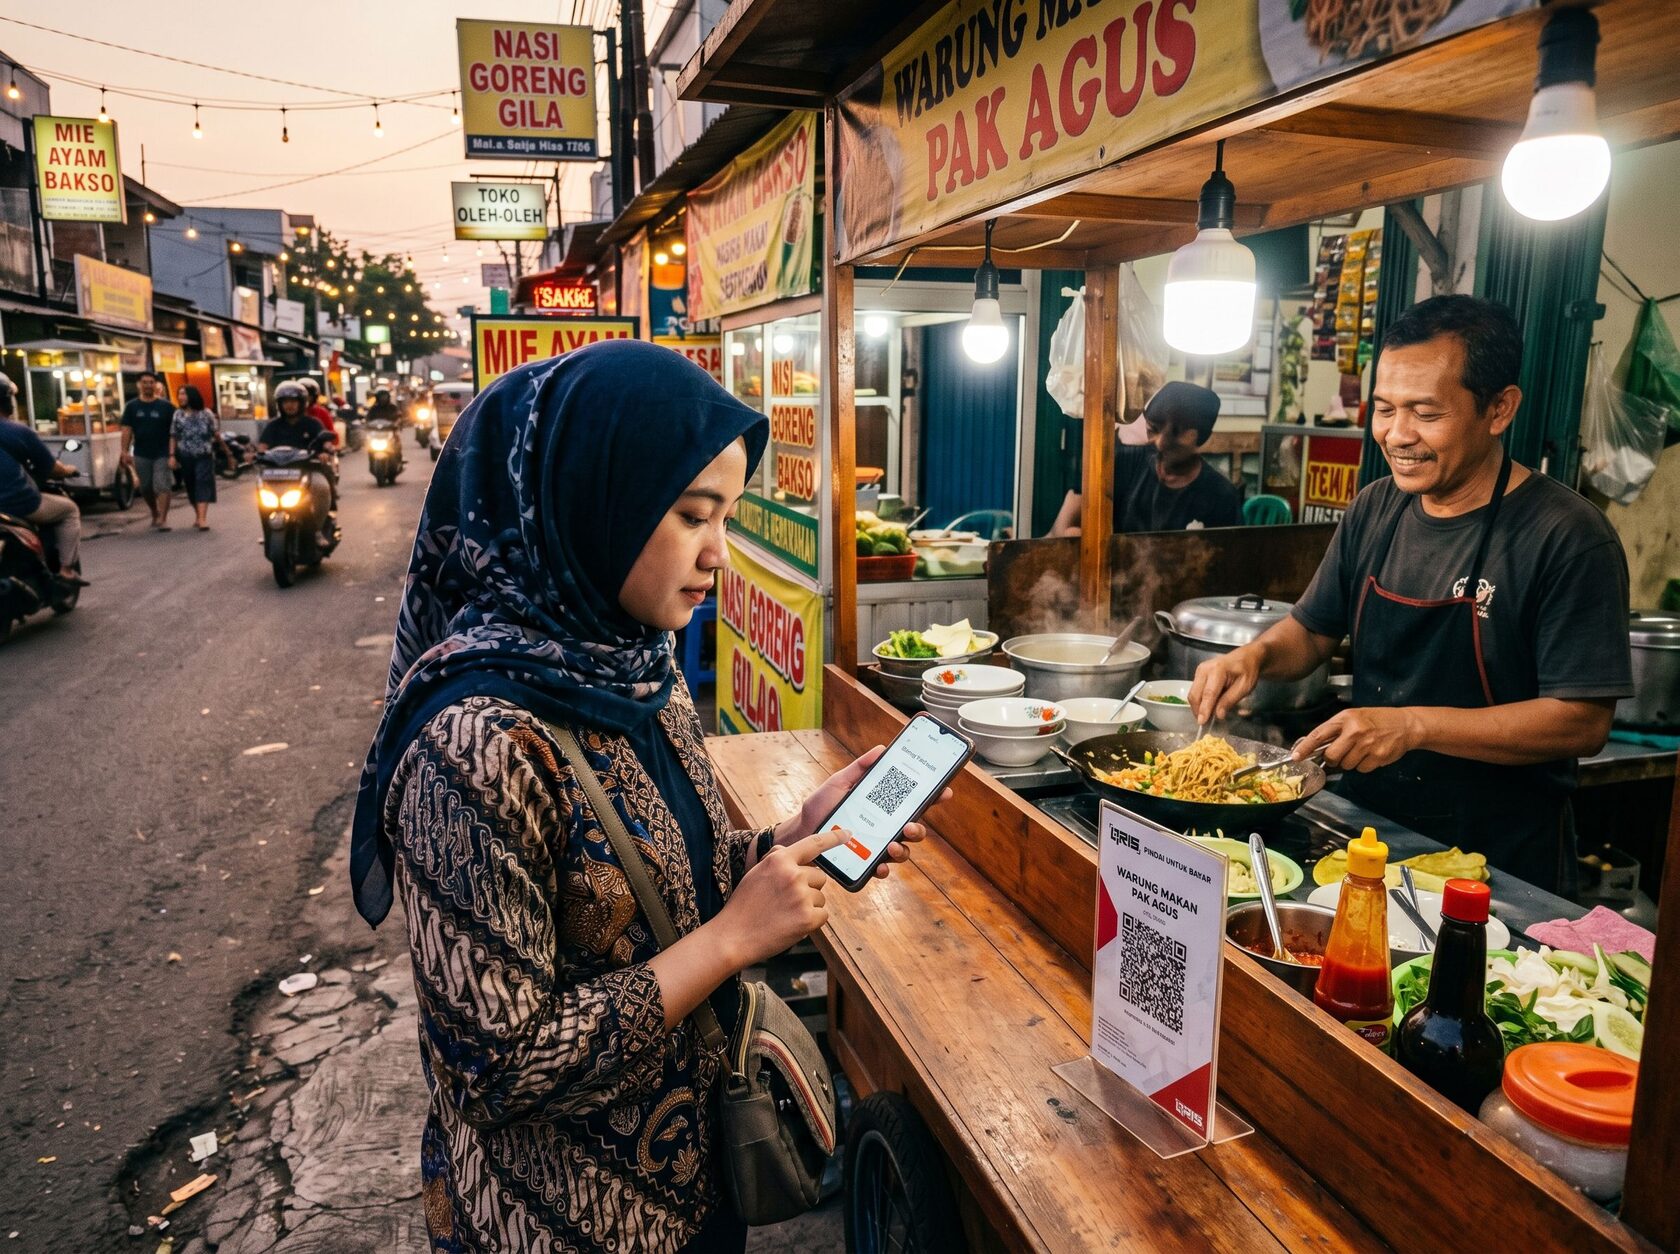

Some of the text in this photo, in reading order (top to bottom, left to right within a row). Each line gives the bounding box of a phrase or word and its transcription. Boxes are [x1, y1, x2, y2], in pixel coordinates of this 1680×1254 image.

[493, 29, 560, 61] NASI
[469, 63, 587, 97] GORENG
[894, 0, 1028, 128] WARUNG
[498, 99, 564, 129] GILA
[926, 0, 1197, 201] PAK AGUS
[55, 122, 95, 144] MIE
[48, 147, 107, 168] AYAM
[44, 171, 115, 193] BAKSO
[478, 188, 520, 203] TOKO
[457, 207, 543, 223] OLEH-OLEH
[771, 404, 815, 448] GORENG
[776, 452, 815, 501] BAKSO
[721, 566, 746, 641] NASI
[748, 580, 806, 693] GORENG
[1110, 826, 1212, 884] QRIS PINDAI UNTUK BAYAR
[1117, 865, 1198, 915] WARUNG MAKAN
[1131, 887, 1150, 905] PAK
[1152, 900, 1179, 920] AGUS
